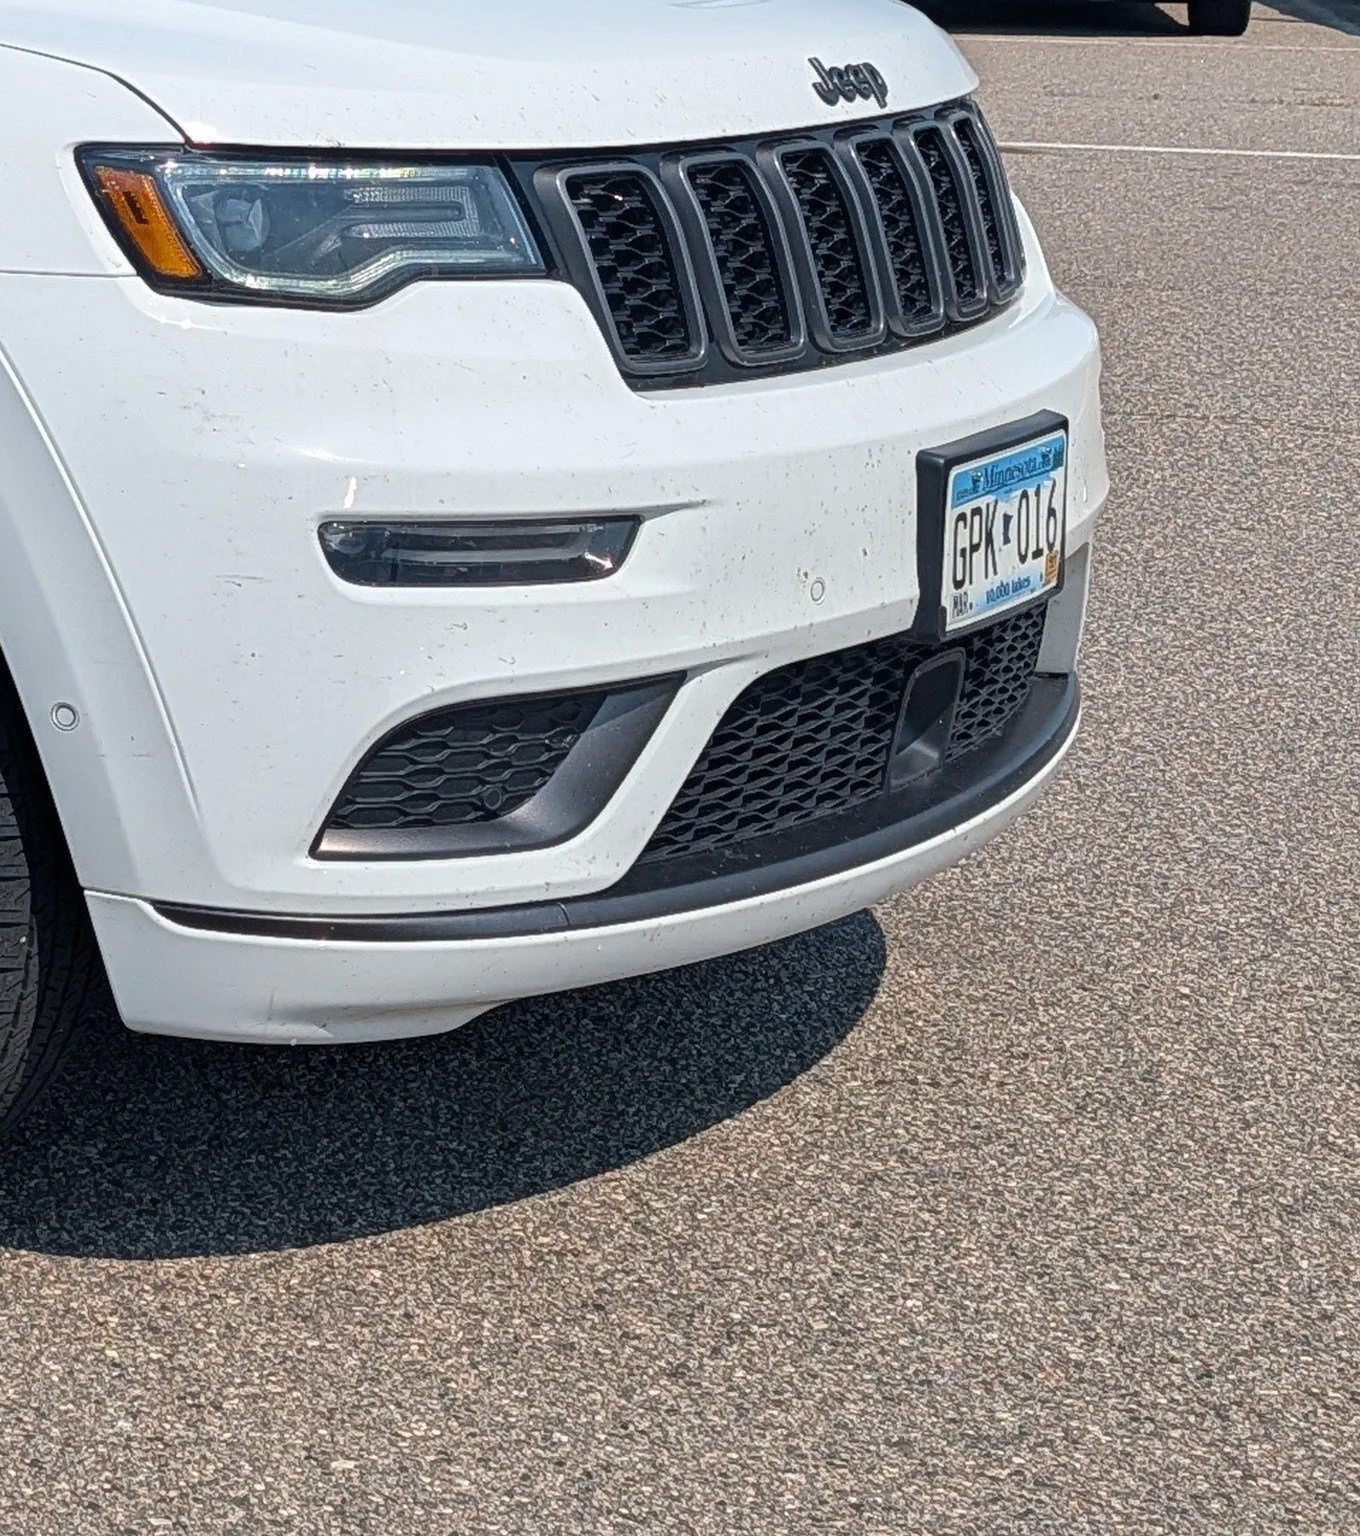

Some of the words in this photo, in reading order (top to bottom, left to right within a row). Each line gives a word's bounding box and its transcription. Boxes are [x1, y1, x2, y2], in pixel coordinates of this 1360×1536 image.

[807, 56, 889, 110] Jeep
[952, 498, 998, 591] GPK
[1017, 478, 1058, 565] 016
